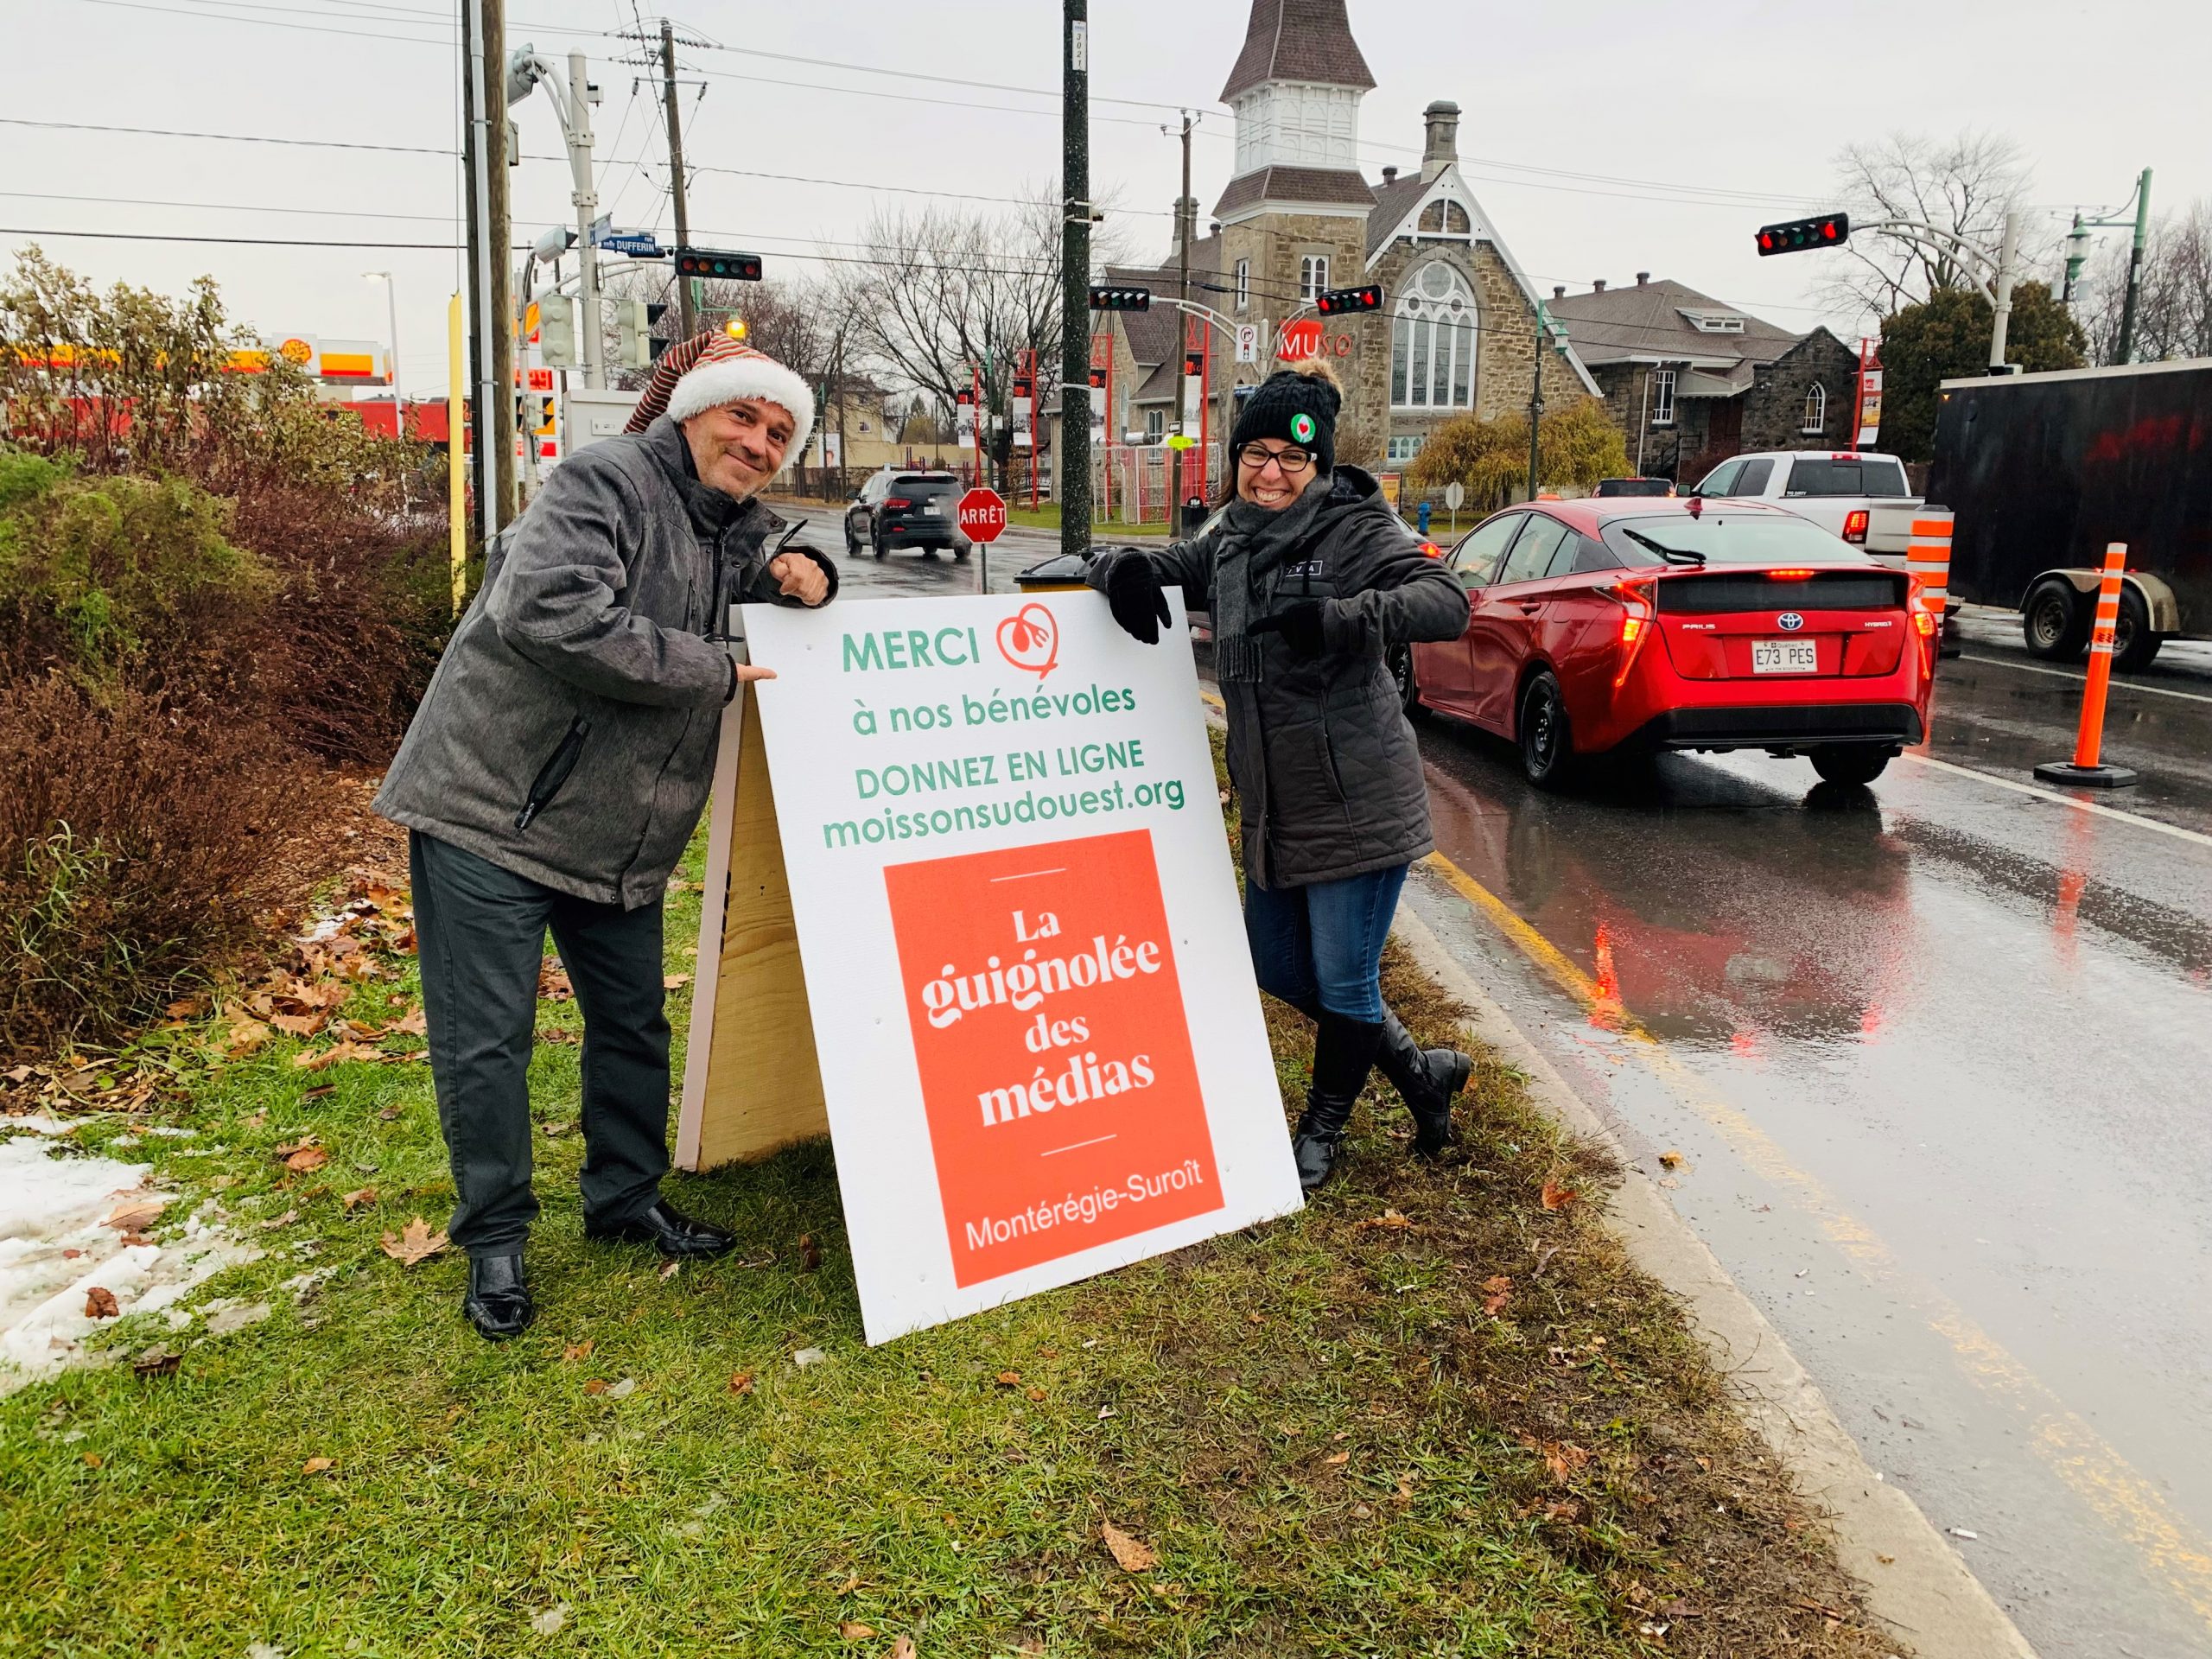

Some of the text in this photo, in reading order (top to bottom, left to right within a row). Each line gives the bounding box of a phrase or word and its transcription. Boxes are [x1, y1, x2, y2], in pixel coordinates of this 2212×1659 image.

[616, 240, 655, 252] DUFFERIN
[1280, 333, 1352, 357] MUSO
[960, 505, 1004, 524] ARRÊT
[842, 626, 981, 672] MERCI
[1756, 648, 1814, 665] E73 PES
[853, 683, 1137, 736] à nos bénévoles
[855, 739, 1145, 799] DONNEZ EN LIGNE
[823, 779, 1186, 849] moissonsudouest.org
[1012, 910, 1062, 943] La
[921, 933, 1162, 1030] guignolée
[1025, 1012, 1090, 1053] des
[976, 1051, 1156, 1127] médias
[964, 1159, 1204, 1251] Montérégie-Suroît
